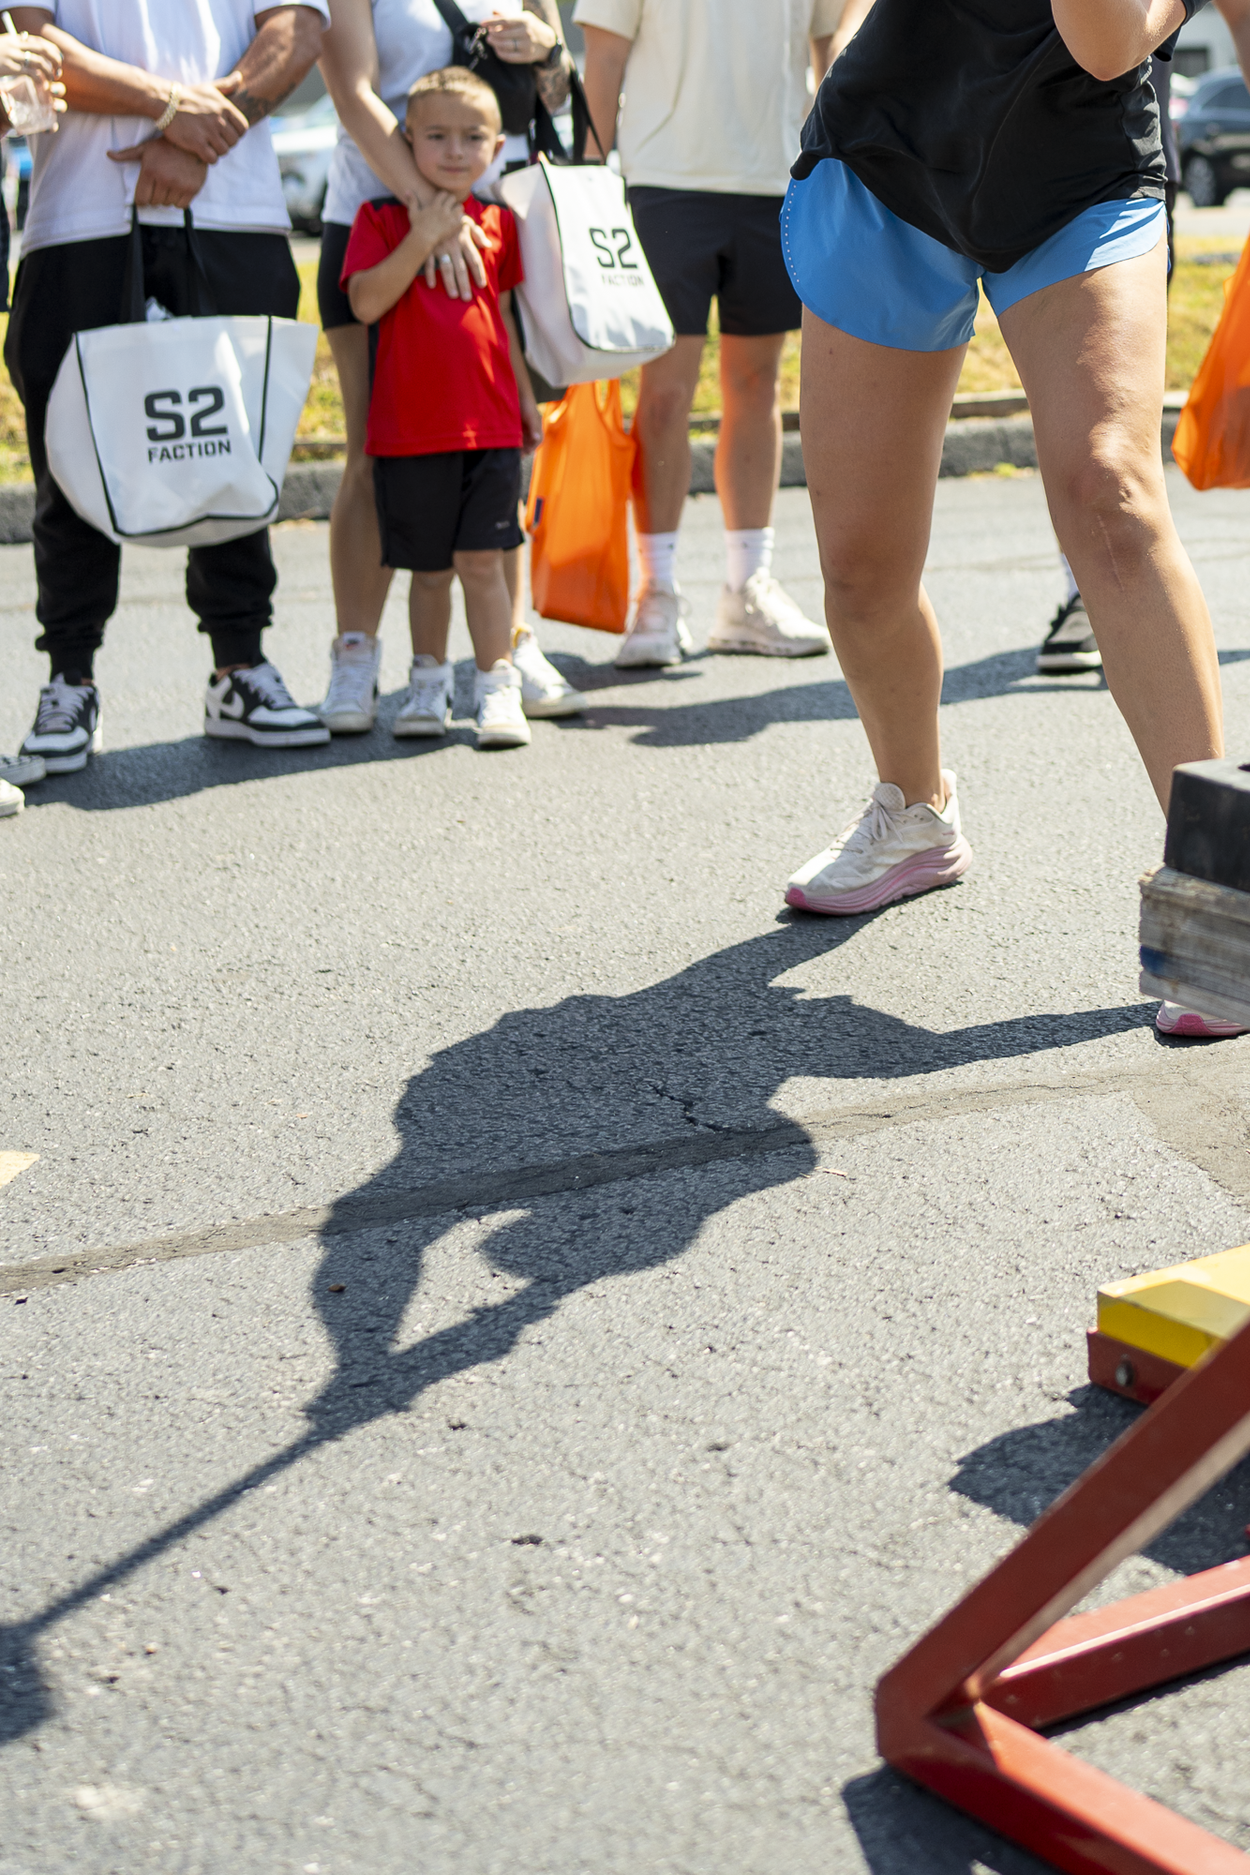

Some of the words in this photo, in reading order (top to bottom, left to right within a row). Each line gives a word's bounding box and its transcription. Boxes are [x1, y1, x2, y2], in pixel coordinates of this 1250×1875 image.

[588, 228, 638, 269] S2
[144, 386, 229, 442] S2
[147, 439, 231, 463] FACTION
